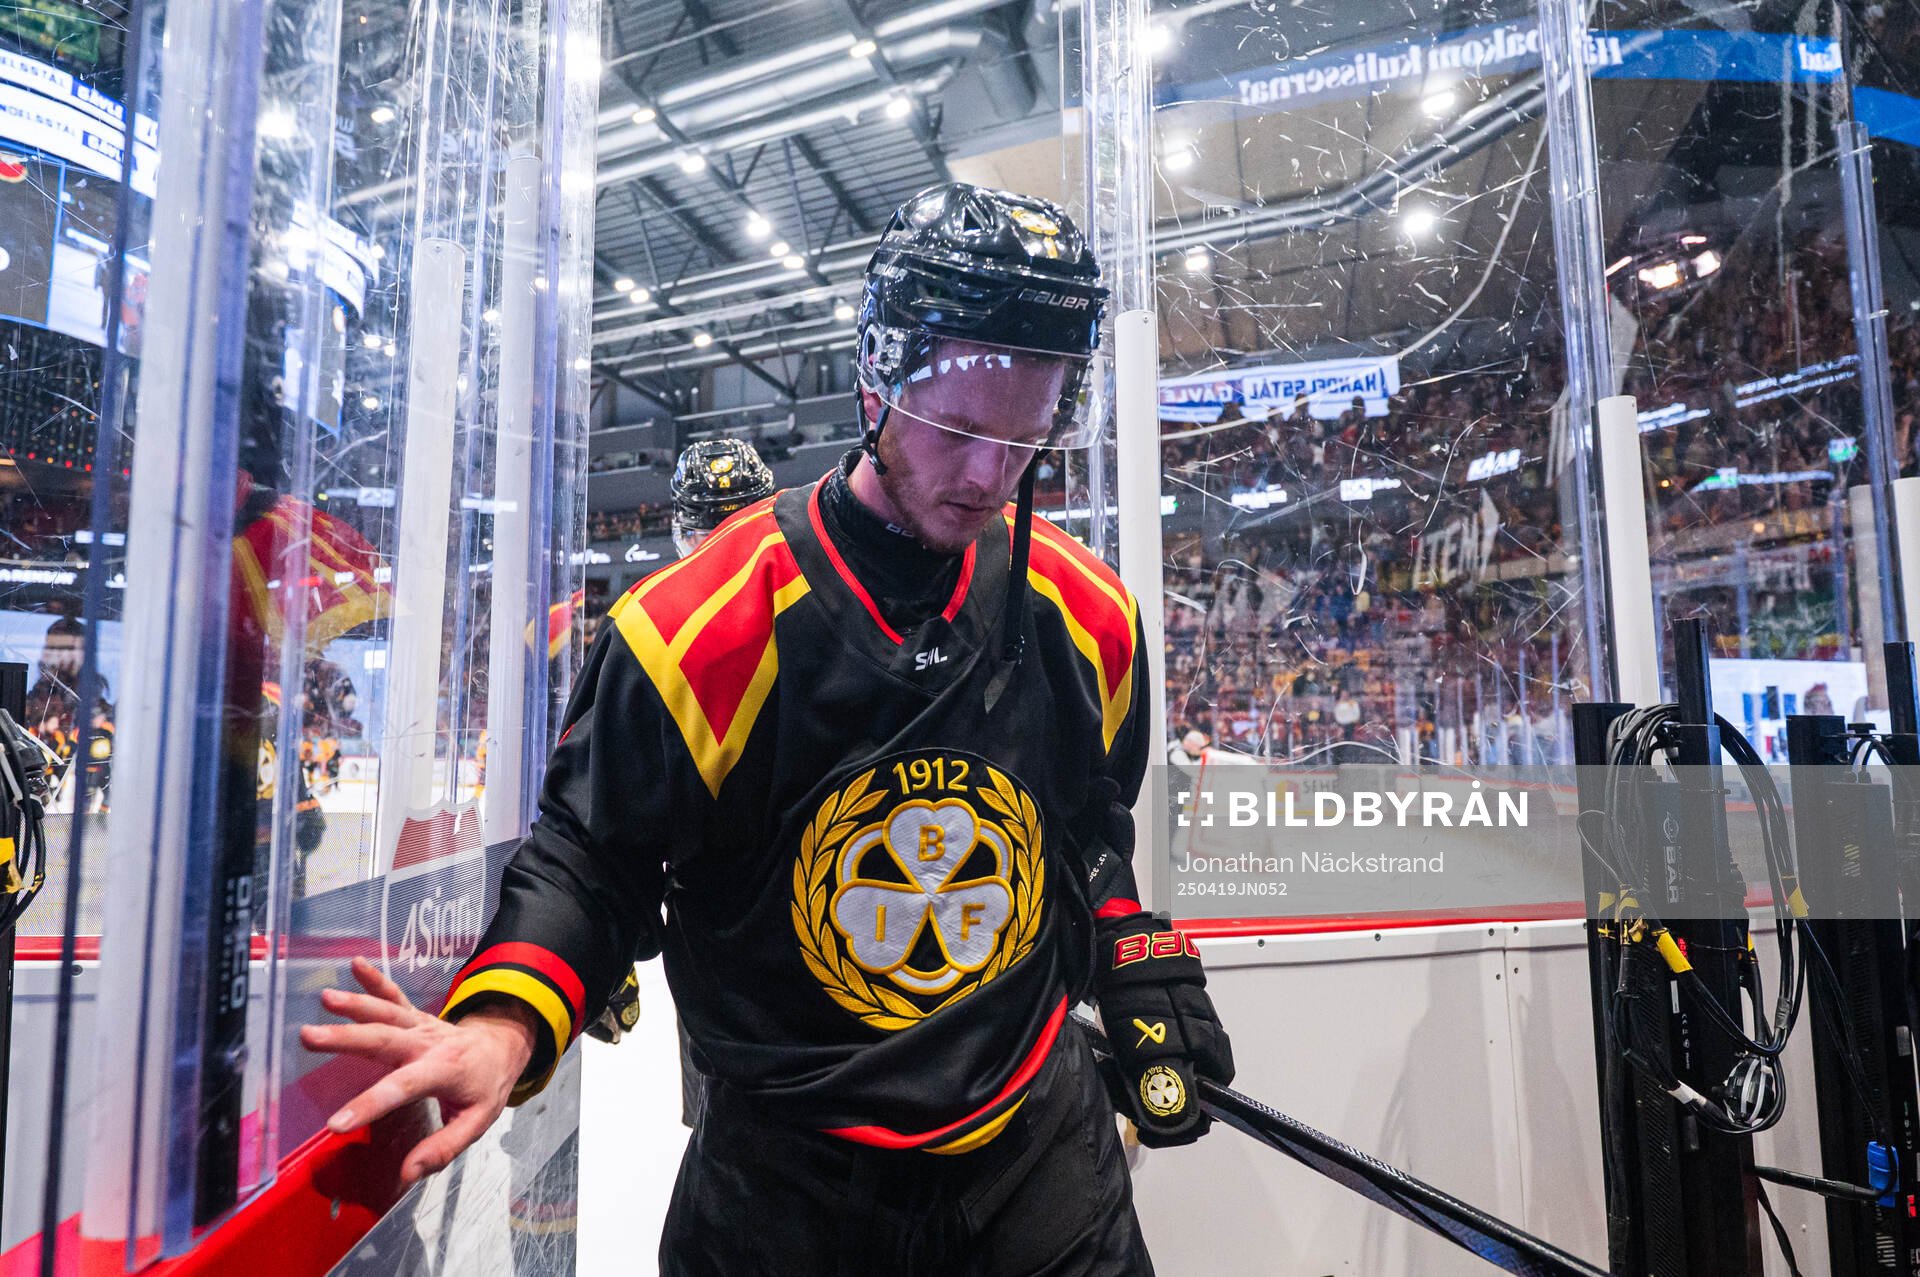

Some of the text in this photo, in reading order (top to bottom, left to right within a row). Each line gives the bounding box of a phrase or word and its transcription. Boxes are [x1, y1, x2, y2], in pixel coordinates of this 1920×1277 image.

[892, 757, 969, 795] 1912
[917, 824, 945, 862] B
[399, 886, 475, 973] 4Sign
[960, 904, 986, 941] F
